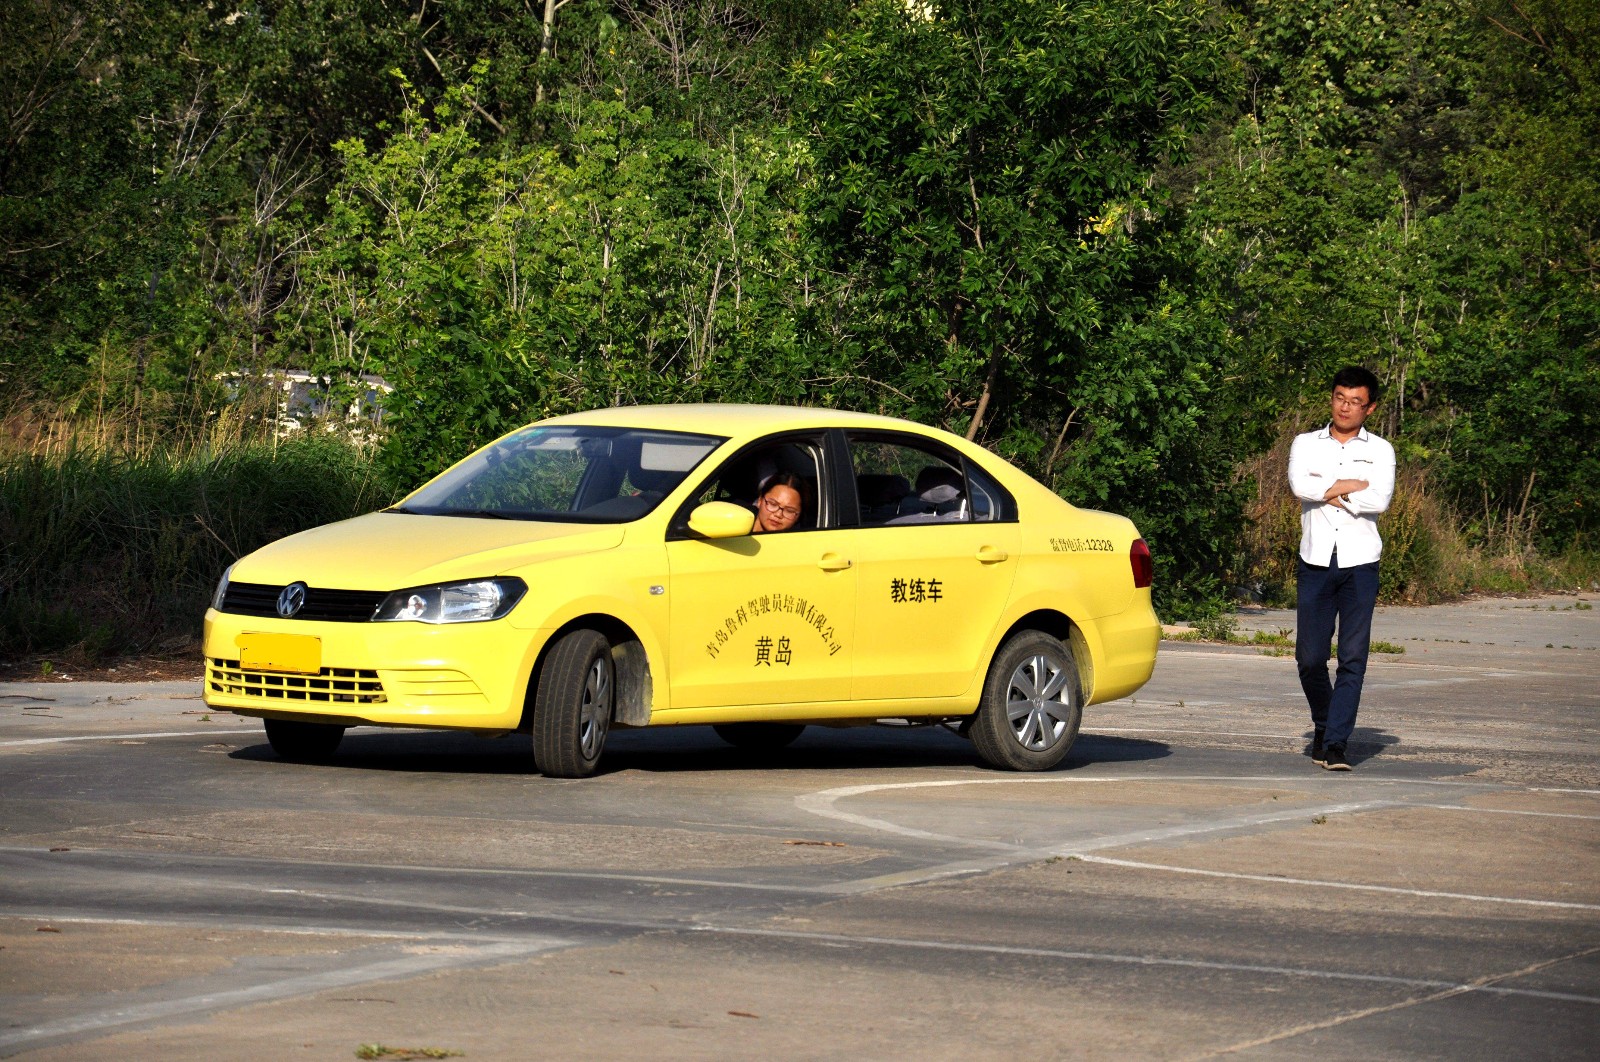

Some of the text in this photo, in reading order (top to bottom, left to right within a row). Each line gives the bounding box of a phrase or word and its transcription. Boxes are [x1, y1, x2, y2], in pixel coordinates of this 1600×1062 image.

[891, 578, 943, 603] 教练车
[754, 635, 792, 667] 黄岛
